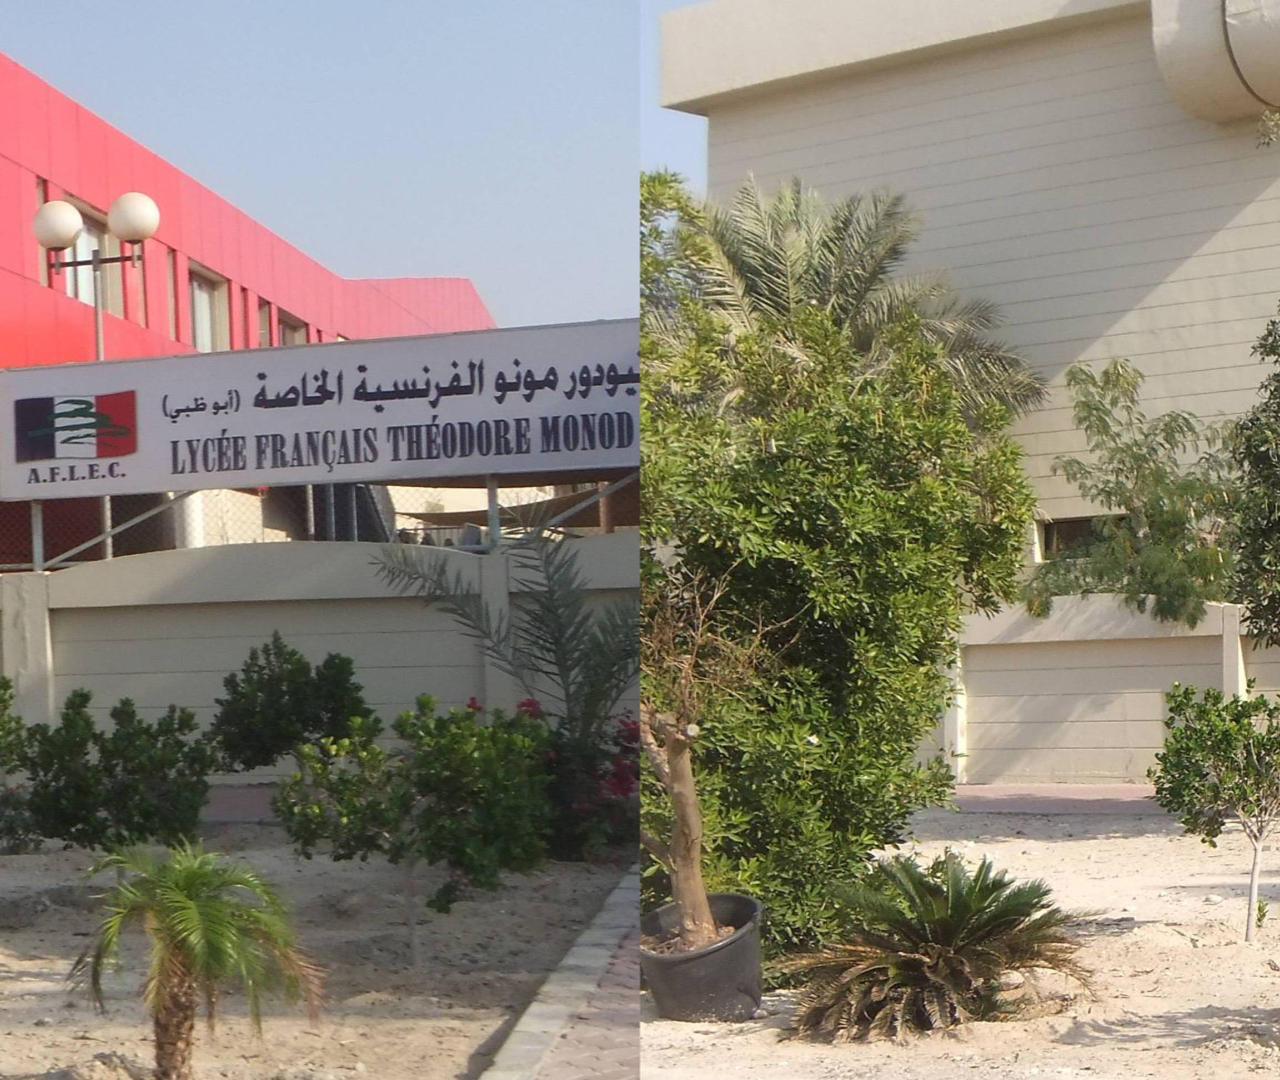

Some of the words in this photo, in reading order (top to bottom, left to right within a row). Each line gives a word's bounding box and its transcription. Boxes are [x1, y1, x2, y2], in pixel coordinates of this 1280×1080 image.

[252, 367, 344, 410] الخاصة
[352, 359, 485, 415] الفرنسية
[493, 358, 559, 405] مونو
[562, 350, 640, 401] يودور
[162, 394, 208, 424] ظبي)
[212, 388, 241, 416] (أبو
[170, 428, 247, 475] LYCÉE
[254, 427, 379, 474] FRANÇAIS
[386, 414, 532, 462] THÉODORE
[538, 410, 635, 455] MONOD
[27, 461, 126, 485] A.F.L.E.C.
